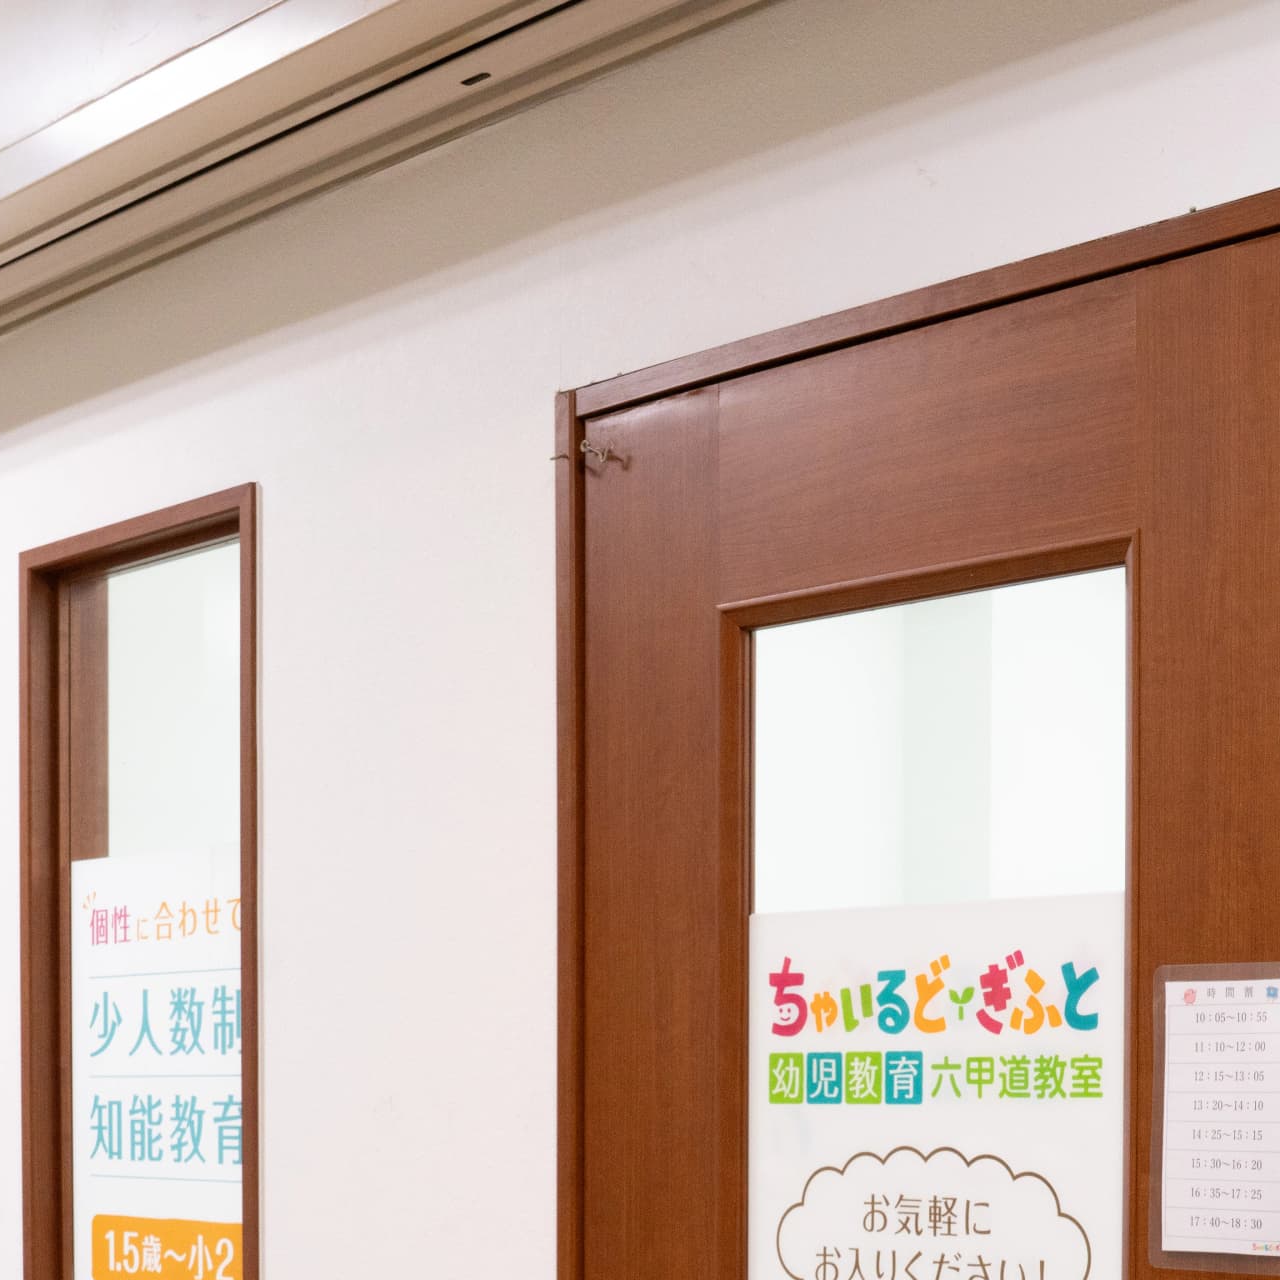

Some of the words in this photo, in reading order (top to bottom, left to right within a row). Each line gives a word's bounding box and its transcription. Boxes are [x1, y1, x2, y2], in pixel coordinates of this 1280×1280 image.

[89, 896, 241, 946] 個性に合わせて
[1206, 985, 1255, 999] 時間割
[89, 985, 241, 1058] 少人数制
[770, 1054, 922, 1102] 幼児教育
[930, 1055, 1104, 1099] 六甲道教室
[89, 1093, 242, 1167] 知能教育
[862, 1193, 992, 1238] お気軽に
